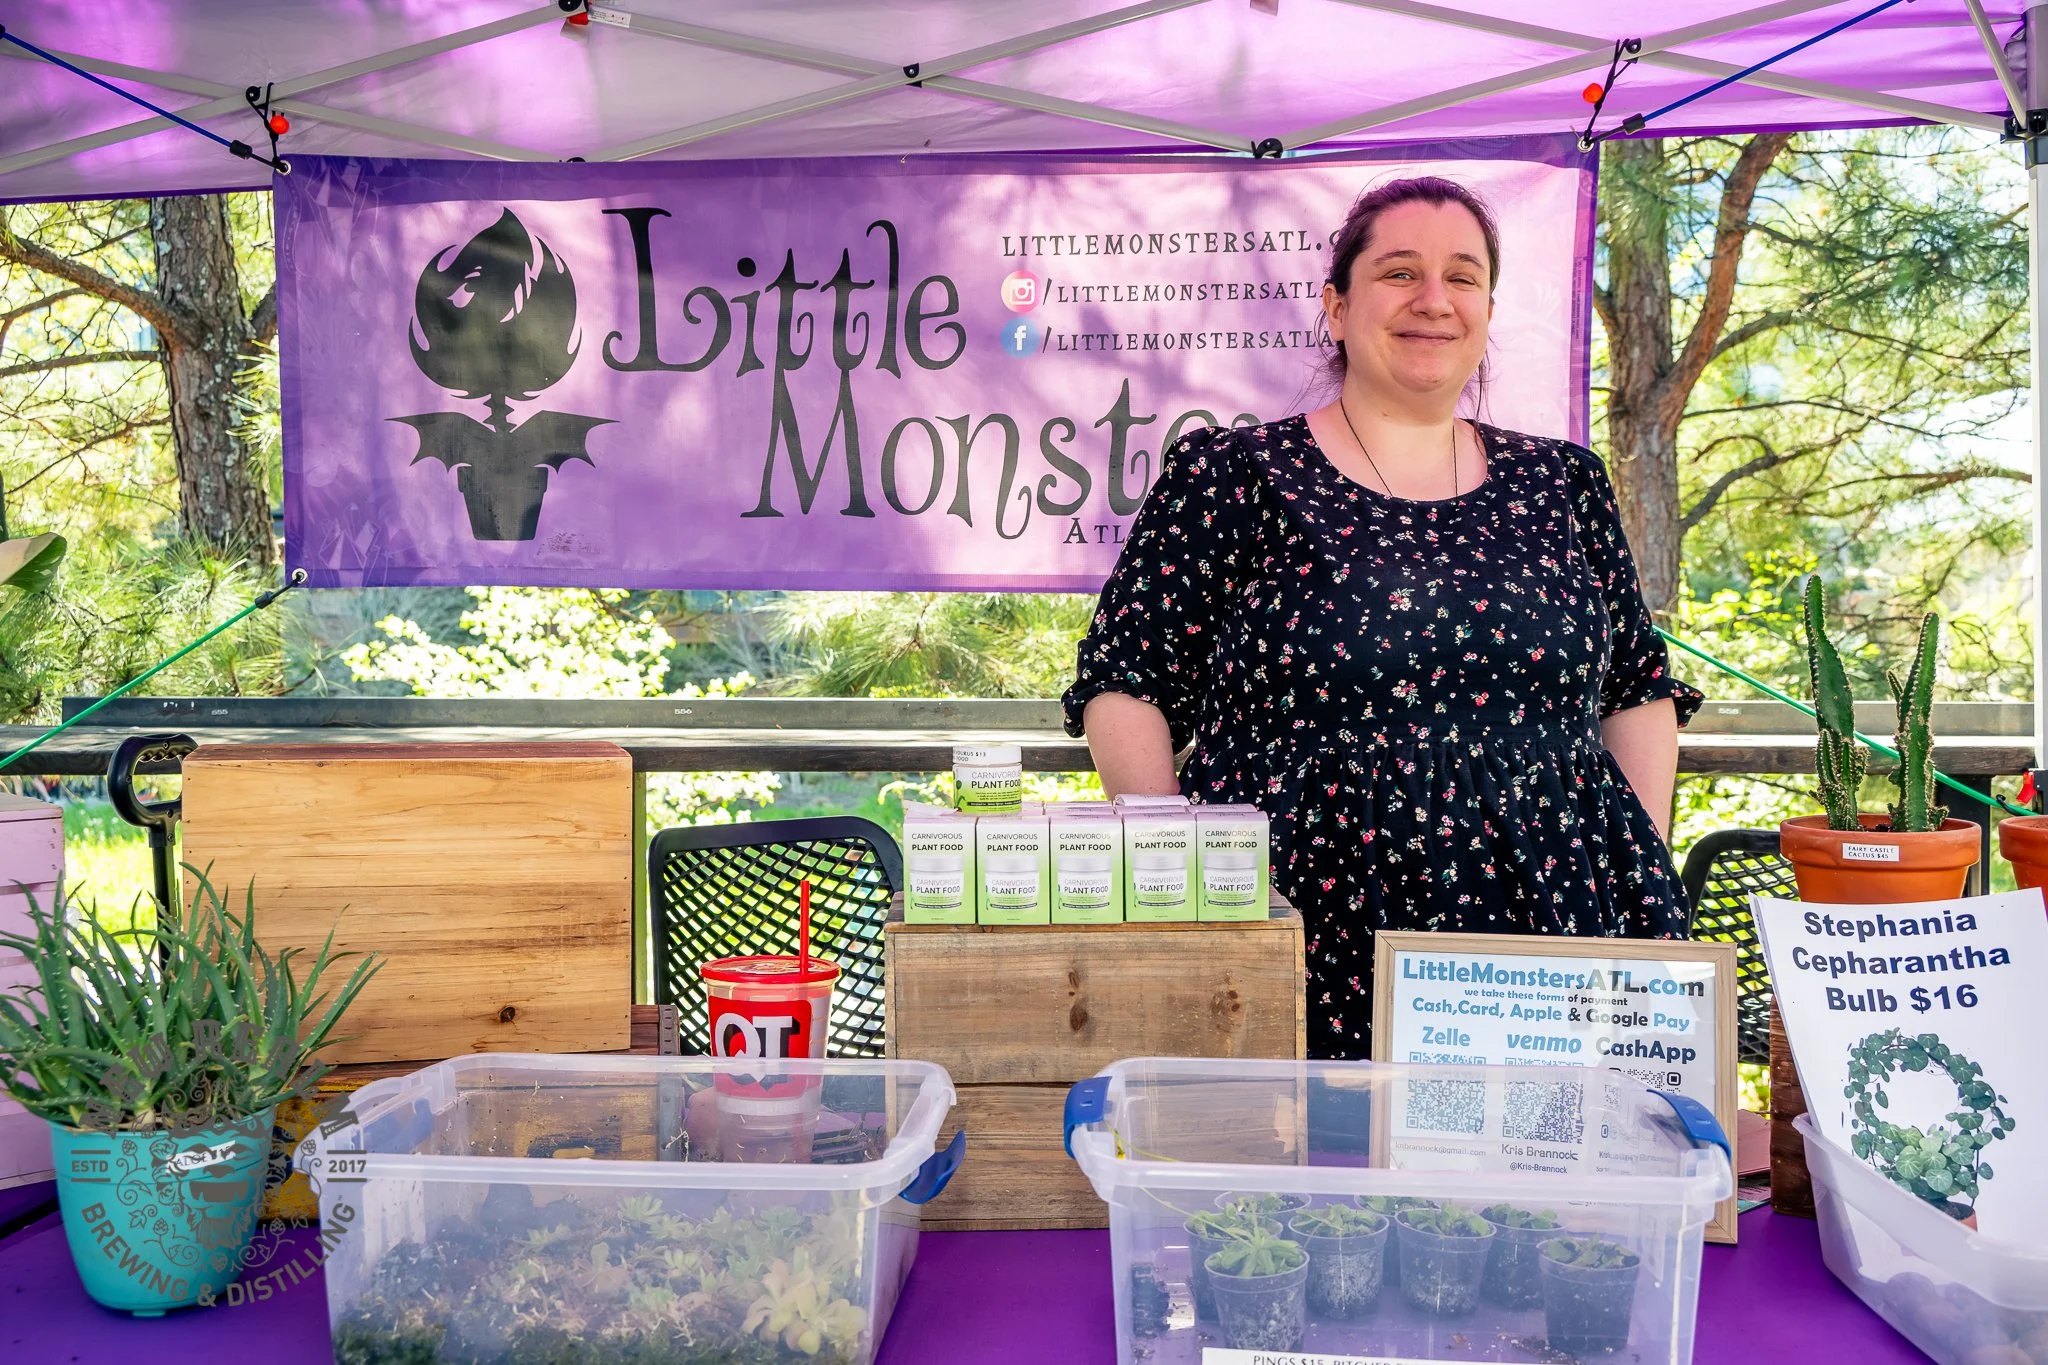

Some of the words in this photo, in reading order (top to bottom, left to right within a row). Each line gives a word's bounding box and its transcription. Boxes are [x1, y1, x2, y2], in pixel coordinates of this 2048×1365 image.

[602, 207, 967, 379] Little
[1043, 278, 1324, 306] /LITTLEMONSTERSATL
[740, 364, 1262, 539] Monst
[971, 780, 1003, 789] PLANT
[1134, 830, 1186, 838] CARNIVOROUS
[987, 844, 1013, 852] PLANT
[916, 886, 940, 894] PLANT
[942, 885, 961, 894] FOOD
[992, 886, 1016, 895] PLANT
[1018, 885, 1036, 894] FOOD
[1064, 886, 1089, 894] PLANT
[1091, 885, 1109, 894] FOOD
[1139, 884, 1164, 892] PLANT
[1166, 883, 1184, 891] FOOD
[1209, 883, 1234, 891] PLANT
[1236, 882, 1255, 890] FOOD
[1803, 909, 1978, 943] Stephania
[1791, 945, 2011, 979] Cepharantha
[1403, 958, 1704, 997] LittleMonstersATL.com
[1481, 989, 1505, 998] take
[1507, 991, 1534, 1000] these
[1536, 992, 1565, 1002] forms
[1568, 994, 1579, 1003] of
[1581, 995, 1628, 1006] payment
[1825, 985, 1898, 1013] Bulb
[1909, 983, 1979, 1014] $16
[1412, 997, 1505, 1019] Cash,Card,
[1510, 1003, 1562, 1022] Apple
[1567, 1007, 1581, 1022] &
[1586, 1008, 1648, 1027] Google
[1653, 1012, 1690, 1031] Pay
[1422, 1026, 1471, 1047] Zelle
[1507, 1033, 1582, 1054] venmo
[715, 1012, 797, 1084] QT
[1596, 1036, 1697, 1065] CashApp
[1501, 1144, 1524, 1156] Kris
[1526, 1146, 1578, 1161] Brannock
[1509, 1162, 1568, 1174] @Kris-Brannock
